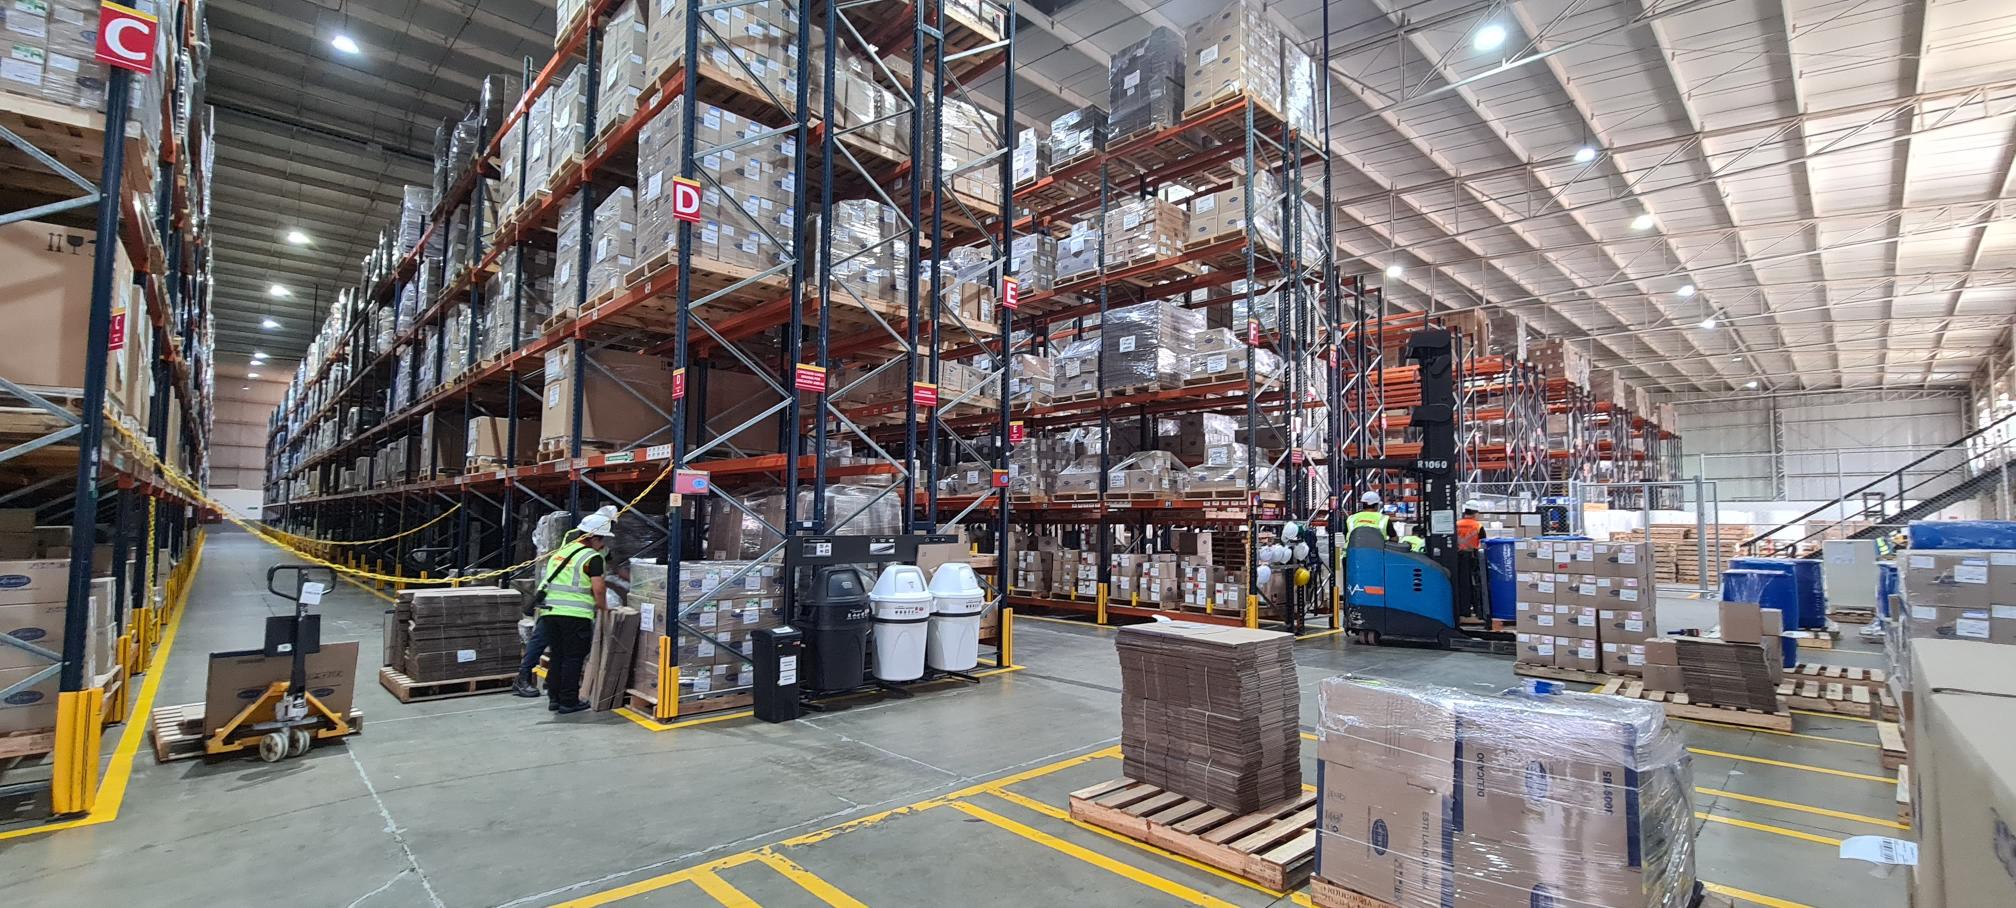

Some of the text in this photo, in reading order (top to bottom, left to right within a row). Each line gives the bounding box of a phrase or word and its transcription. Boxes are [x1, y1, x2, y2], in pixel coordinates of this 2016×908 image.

[105, 17, 150, 61] C
[676, 183, 700, 214] D
[1006, 281, 1017, 305] E
[1250, 322, 1257, 340] F
[1013, 425, 1018, 433] E
[1477, 752, 1485, 798] DELICADO
